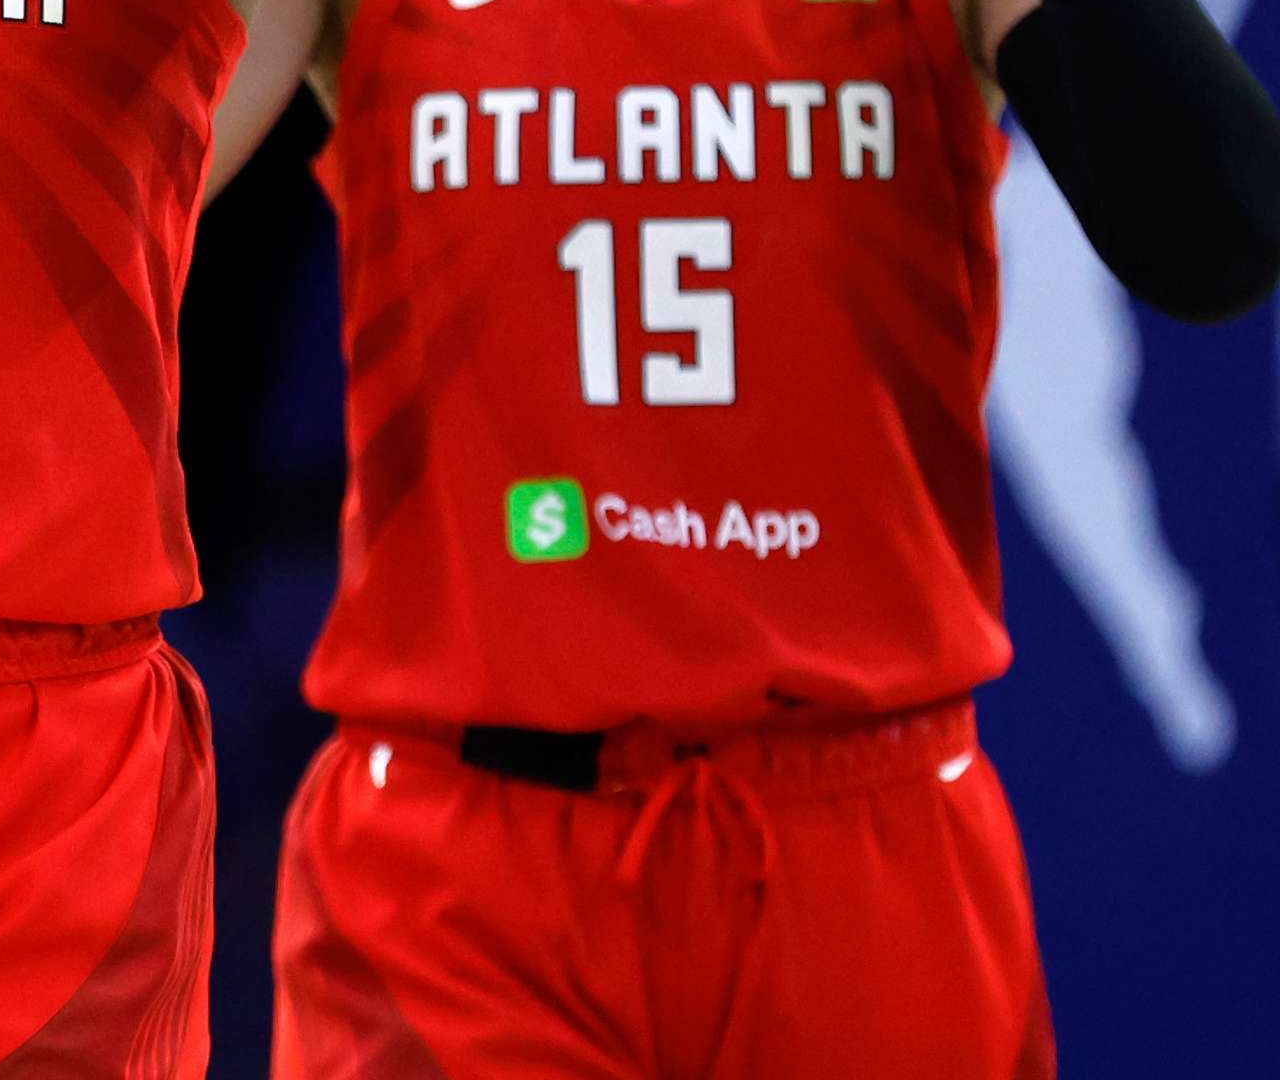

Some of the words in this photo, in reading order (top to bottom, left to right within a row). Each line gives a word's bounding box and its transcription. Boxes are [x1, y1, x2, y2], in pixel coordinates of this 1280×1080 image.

[410, 81, 895, 192] ATLANTA
[557, 218, 736, 406] 15
[594, 492, 708, 550] Cash
[715, 500, 821, 559] App
